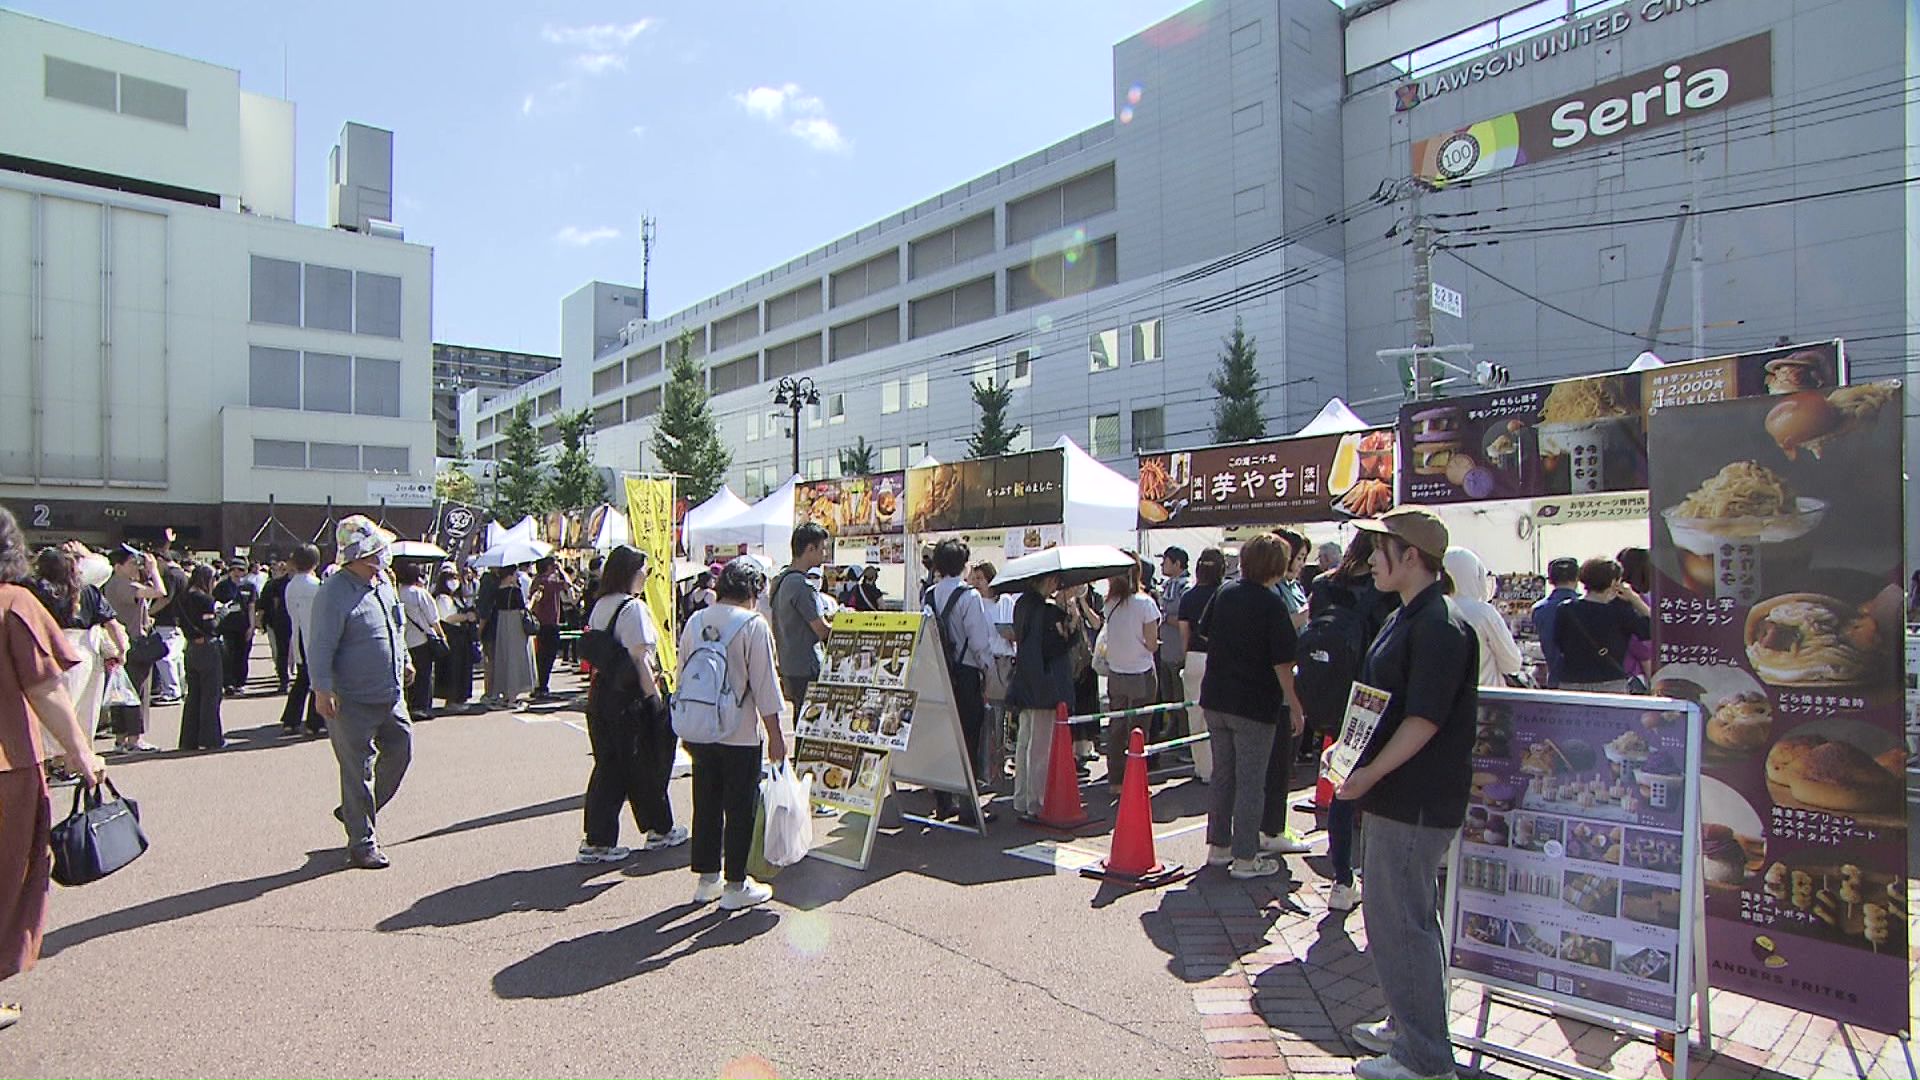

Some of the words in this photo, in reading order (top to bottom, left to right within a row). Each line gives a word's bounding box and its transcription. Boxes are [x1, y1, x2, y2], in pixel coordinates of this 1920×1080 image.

[1421, 47, 1526, 101] LAWSON
[1532, 10, 1631, 61] UNITED
[1551, 65, 1729, 149] Seria
[1444, 144, 1471, 168] 100
[1211, 467, 1294, 501] 芋やす
[33, 504, 50, 527] 2
[1660, 598, 1735, 612] みたらし芋
[1661, 612, 1733, 625] モンブラン
[1660, 643, 1719, 655] 芋モンブラン
[1660, 653, 1738, 666] 生シュークリーム
[1779, 703, 1836, 716] モンブラン
[1771, 817, 1876, 841] カスタードスイート
[1740, 889, 1774, 905] 焼き芋
[1740, 900, 1817, 923] スイートポテト
[1791, 978, 1858, 1004] FRITES
